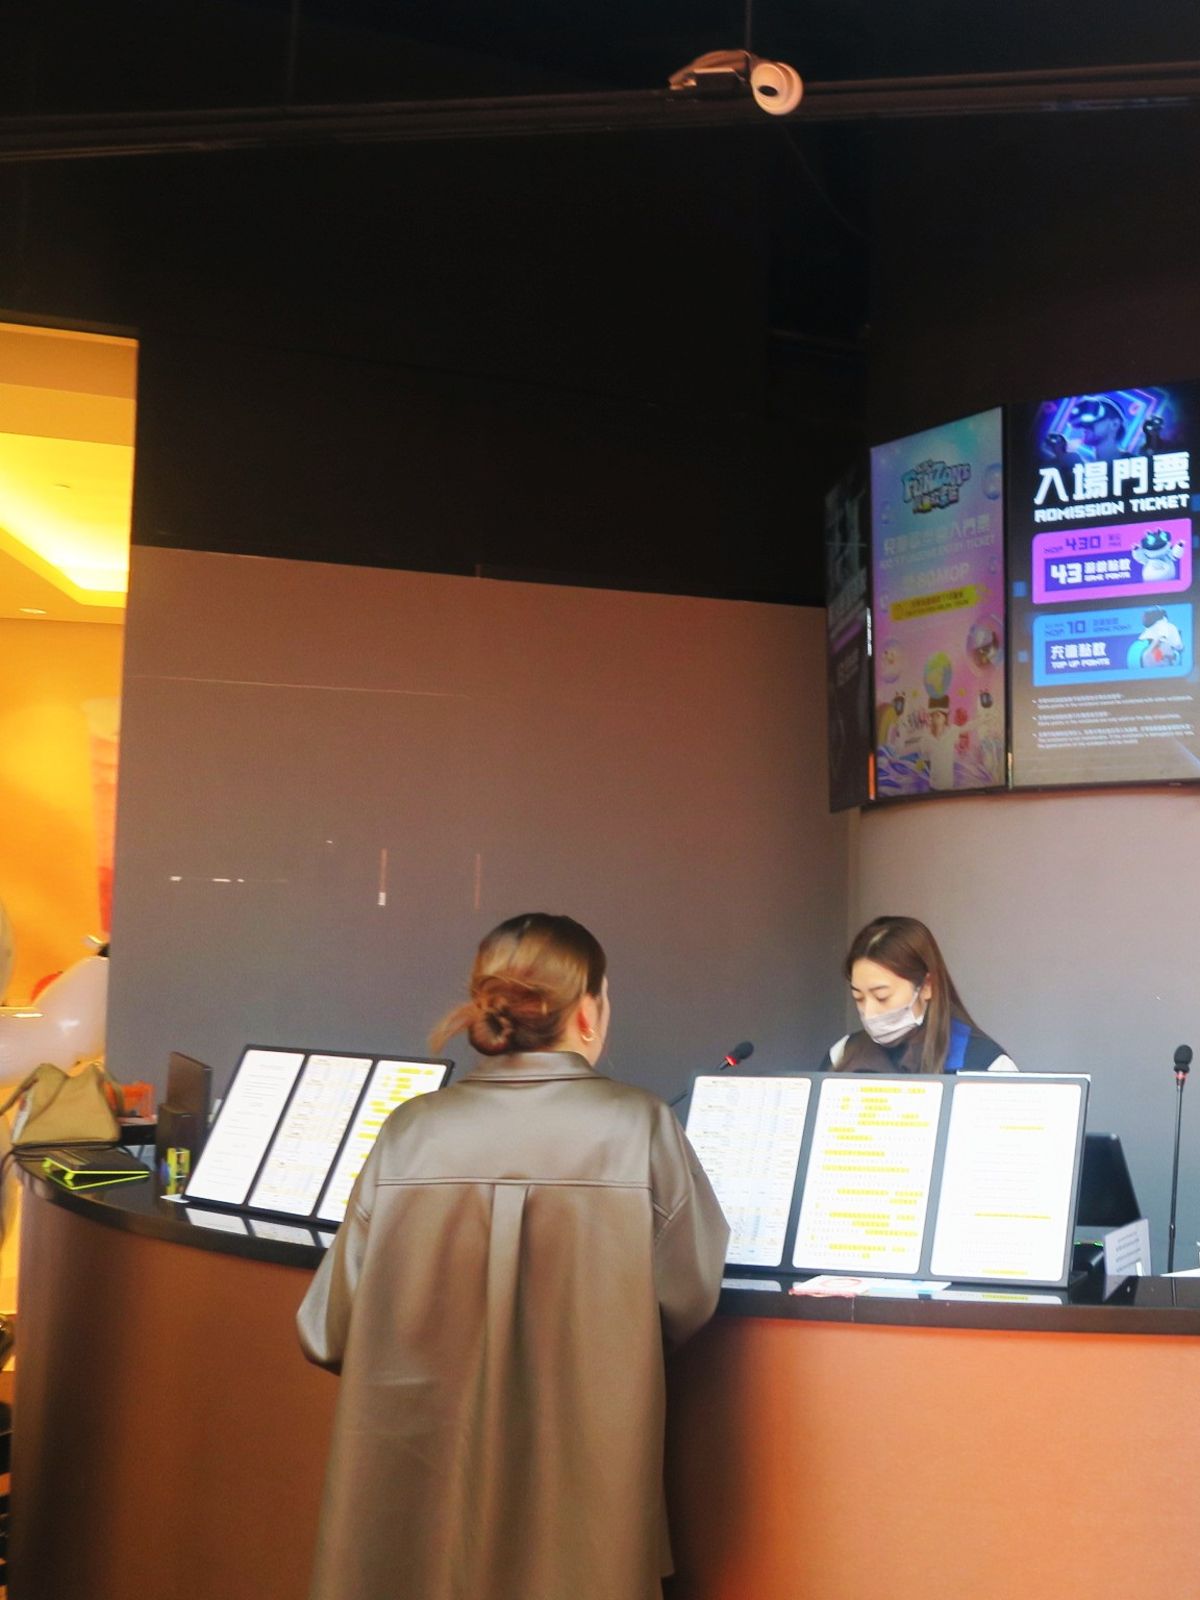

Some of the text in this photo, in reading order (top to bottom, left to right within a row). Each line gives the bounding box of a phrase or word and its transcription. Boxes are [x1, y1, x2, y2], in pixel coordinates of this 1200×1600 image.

[1033, 451, 1190, 505] 入場門票
[1034, 493, 1190, 523] ADMISSION TICKET
[1065, 535, 1102, 551] 430
[1050, 562, 1083, 585] 43
[1067, 620, 1087, 635] 10
